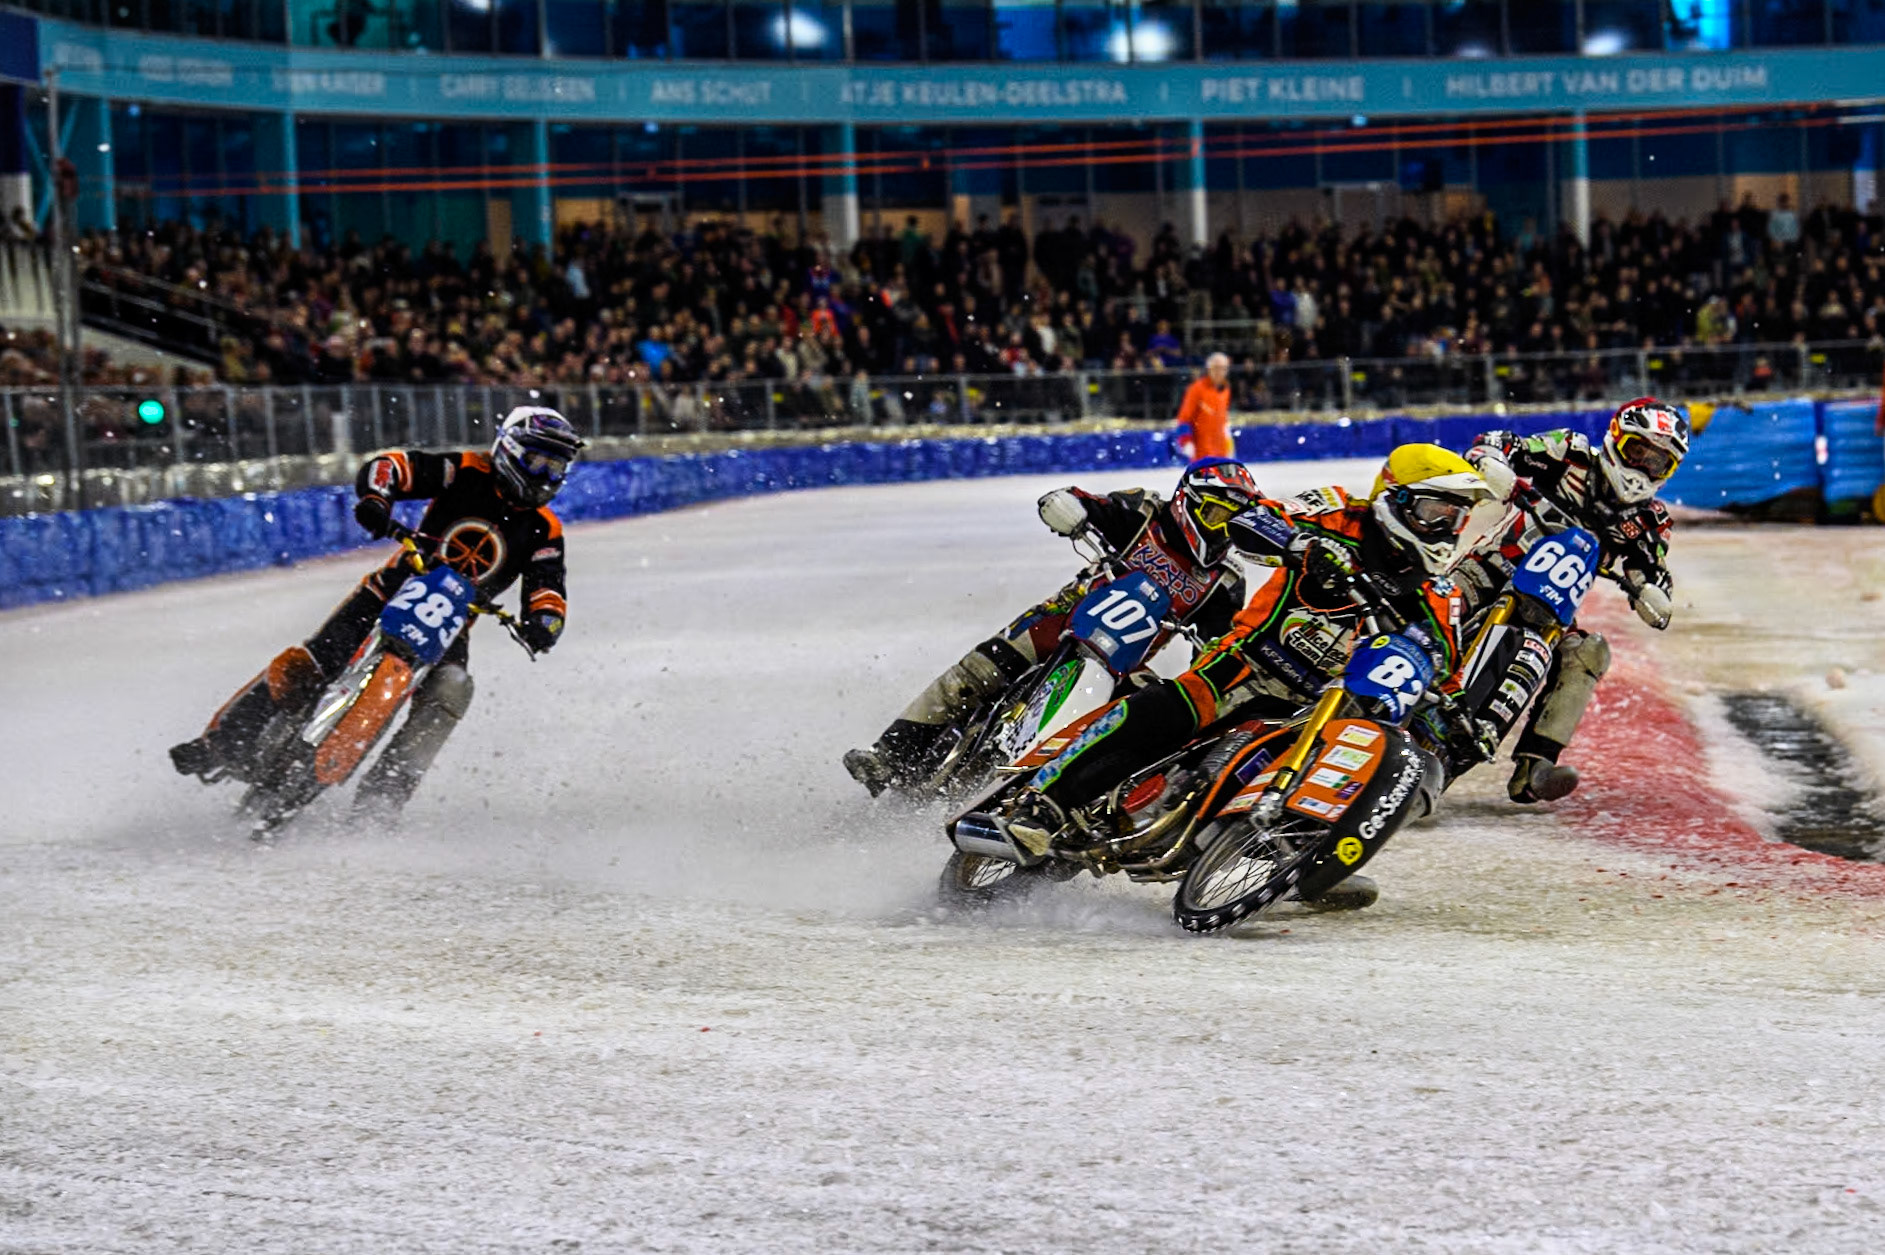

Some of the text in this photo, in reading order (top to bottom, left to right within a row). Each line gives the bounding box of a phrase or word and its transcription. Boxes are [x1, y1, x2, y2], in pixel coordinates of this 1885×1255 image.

[651, 80, 695, 104] ANS
[701, 80, 771, 105] SCHUT
[1202, 78, 1261, 102] PIET
[1268, 76, 1364, 102] KLEINE
[1446, 72, 1555, 98] HILBERT
[1562, 70, 1618, 94] VAN
[1628, 68, 1683, 92] DER
[1692, 65, 1767, 91] DUIM
[387, 581, 464, 649] 283
[1087, 589, 1158, 645] 107
